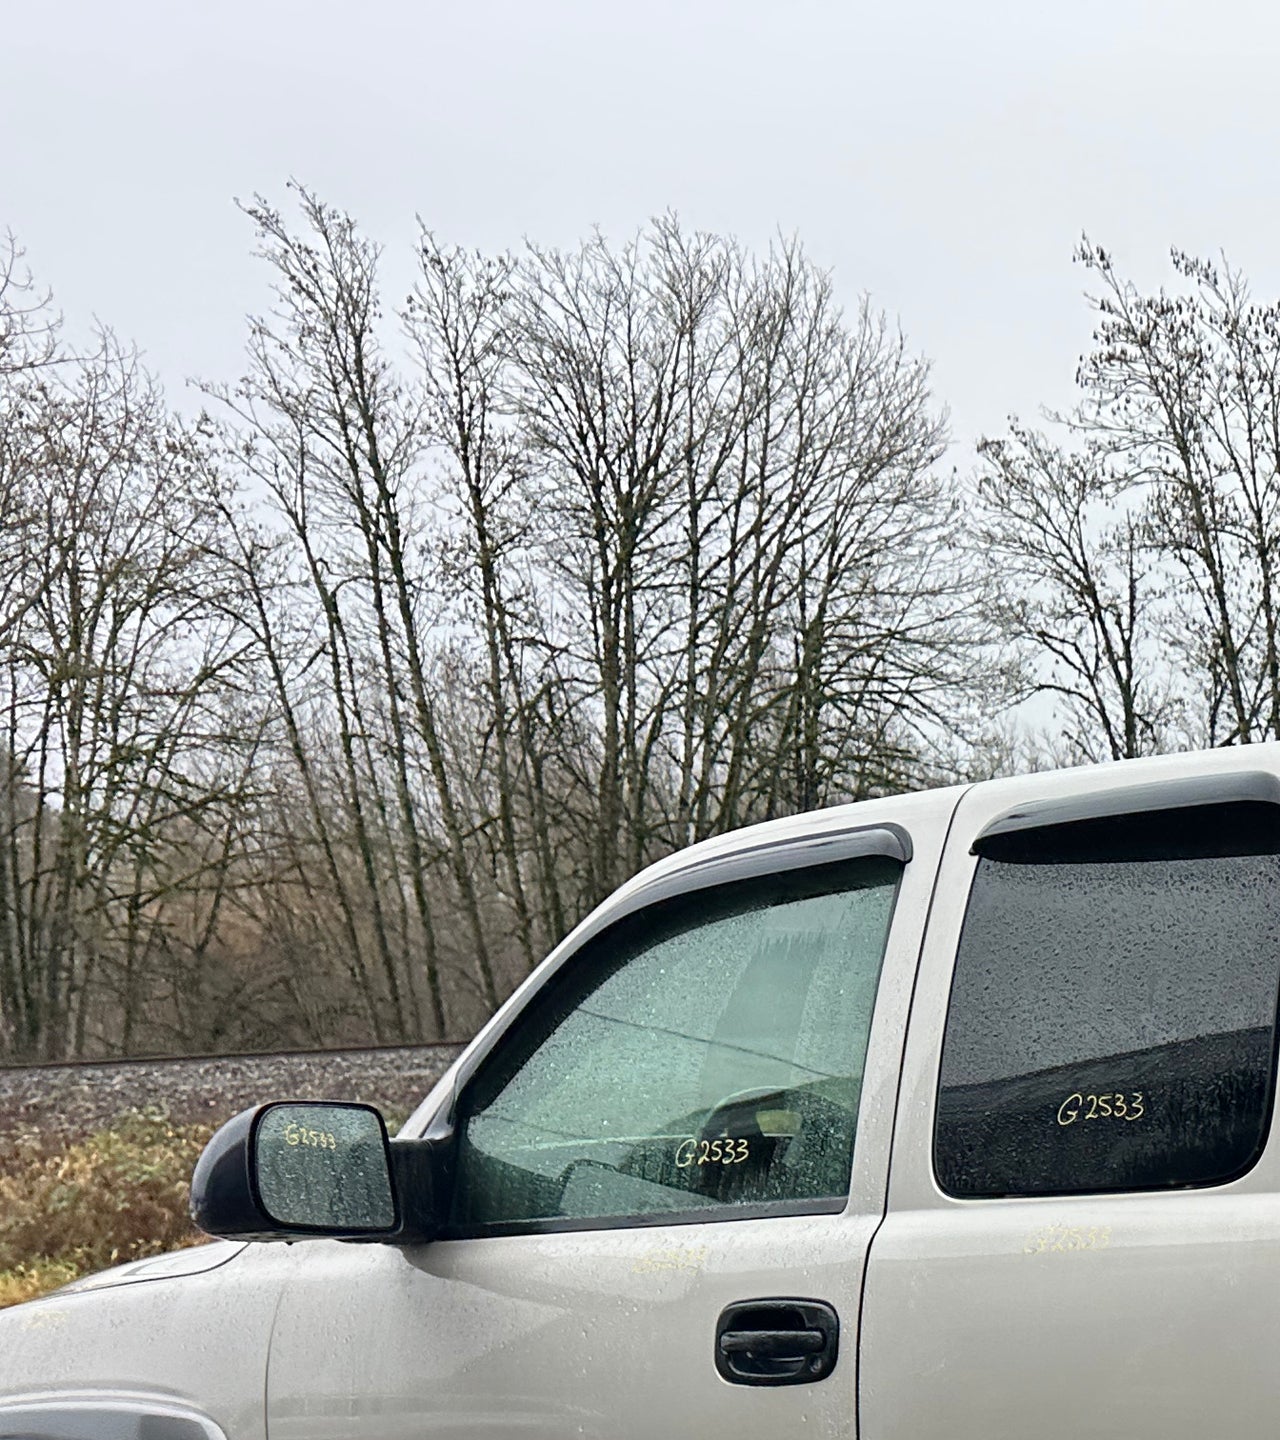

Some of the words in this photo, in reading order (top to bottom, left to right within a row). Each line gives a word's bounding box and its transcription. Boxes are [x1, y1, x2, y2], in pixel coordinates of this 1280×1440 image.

[1057, 1093, 1145, 1126] G2533
[284, 1123, 337, 1151] G2533
[674, 1138, 750, 1168] G2533
